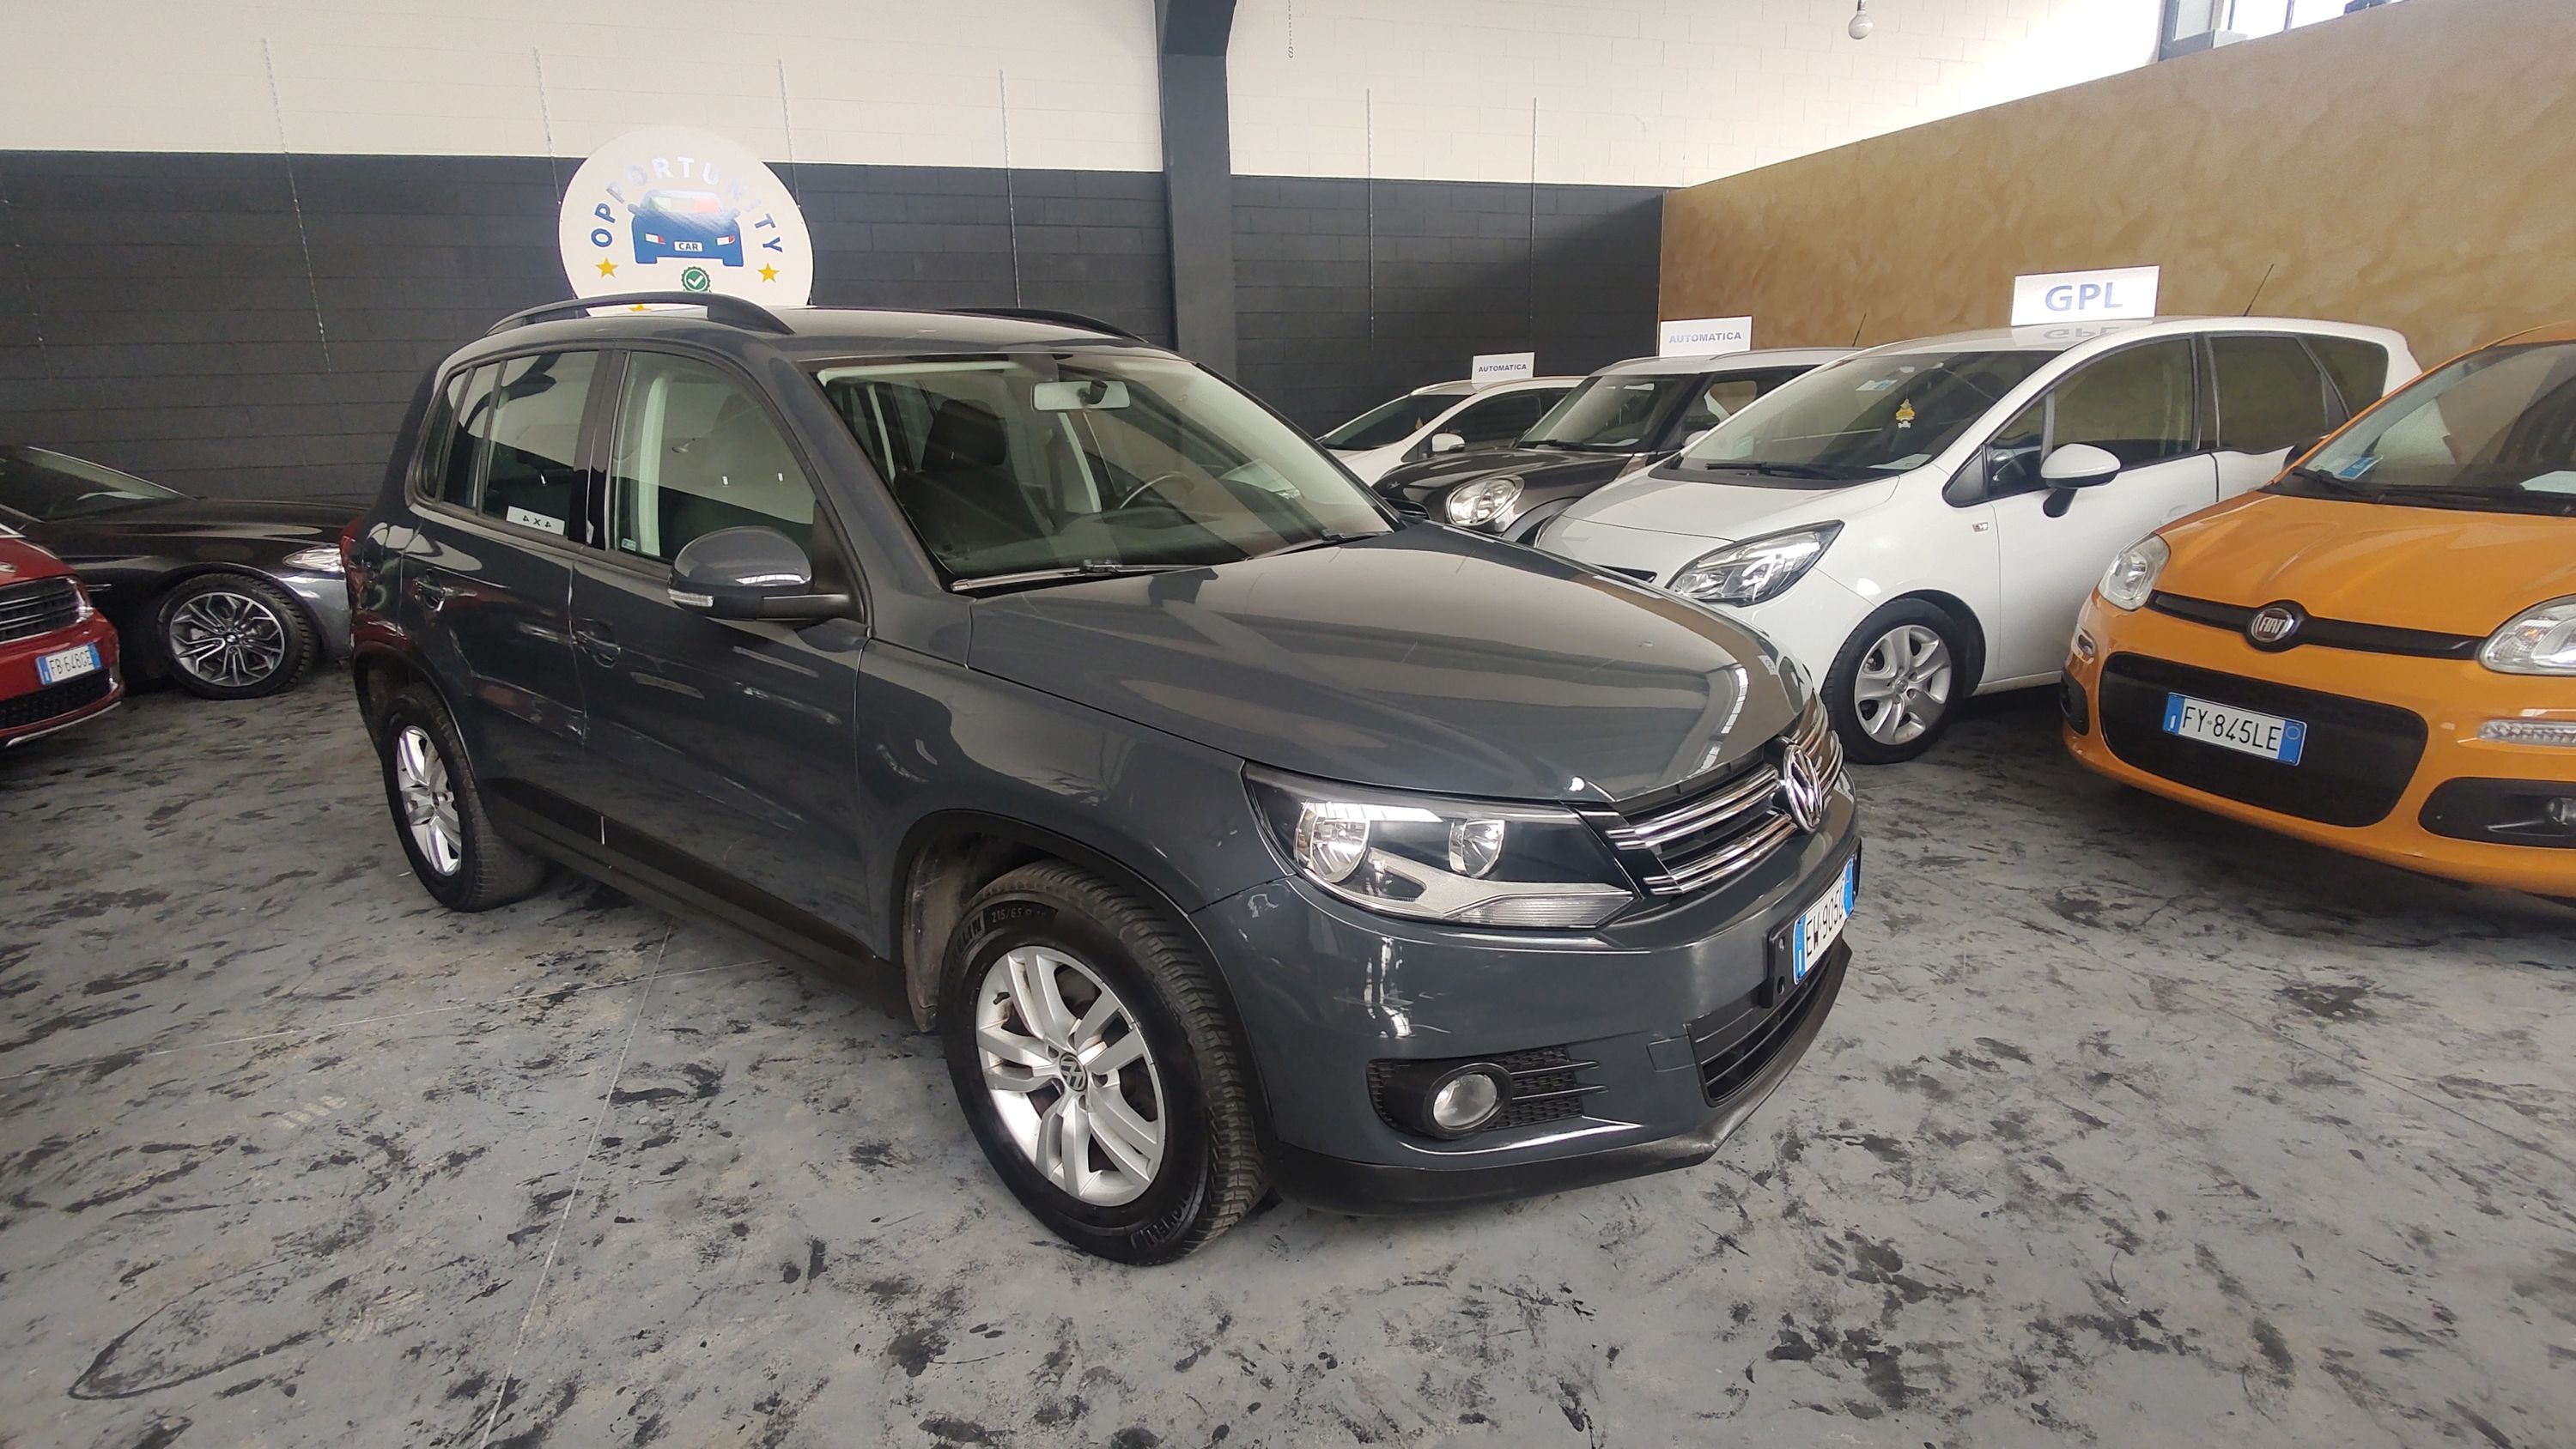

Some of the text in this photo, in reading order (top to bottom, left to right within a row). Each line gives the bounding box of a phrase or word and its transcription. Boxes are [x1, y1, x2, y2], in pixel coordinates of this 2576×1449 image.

[677, 242, 700, 252] CAR
[2045, 282, 2123, 311] GPL
[1668, 331, 1742, 343] AUTOMATICA
[1478, 363, 1527, 373] AUTOMATICA
[2259, 616, 2286, 634] FIAT
